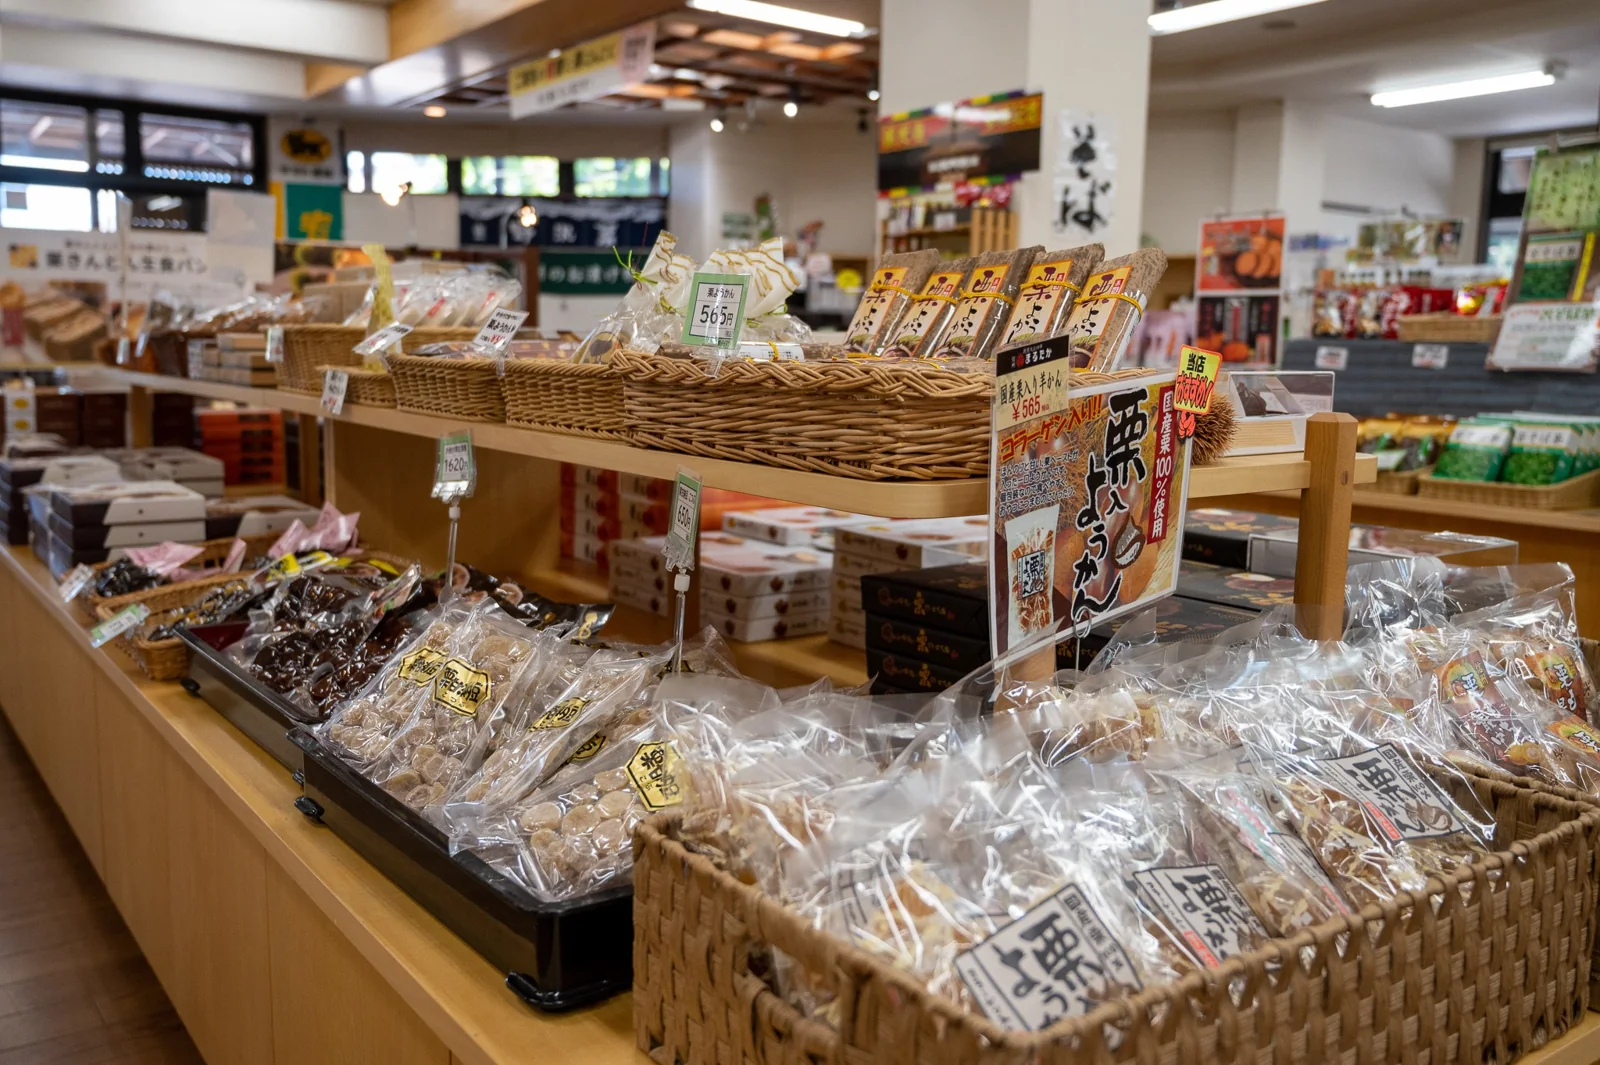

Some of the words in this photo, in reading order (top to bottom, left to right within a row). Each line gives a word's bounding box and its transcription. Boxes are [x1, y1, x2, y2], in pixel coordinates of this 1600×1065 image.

[1055, 124, 1112, 234] そば
[706, 287, 736, 299] 栗ようかん
[699, 304, 734, 326] 565円
[1024, 347, 1053, 365] まるたか
[1186, 353, 1207, 373] 当店
[1000, 369, 1062, 405] 国産栗入り羊かん
[1175, 370, 1214, 409] おすすめ!
[1012, 395, 1041, 421] ¥565
[1001, 393, 1103, 462] コラーゲン入り!!
[1151, 391, 1175, 540] 国産栗100%使用
